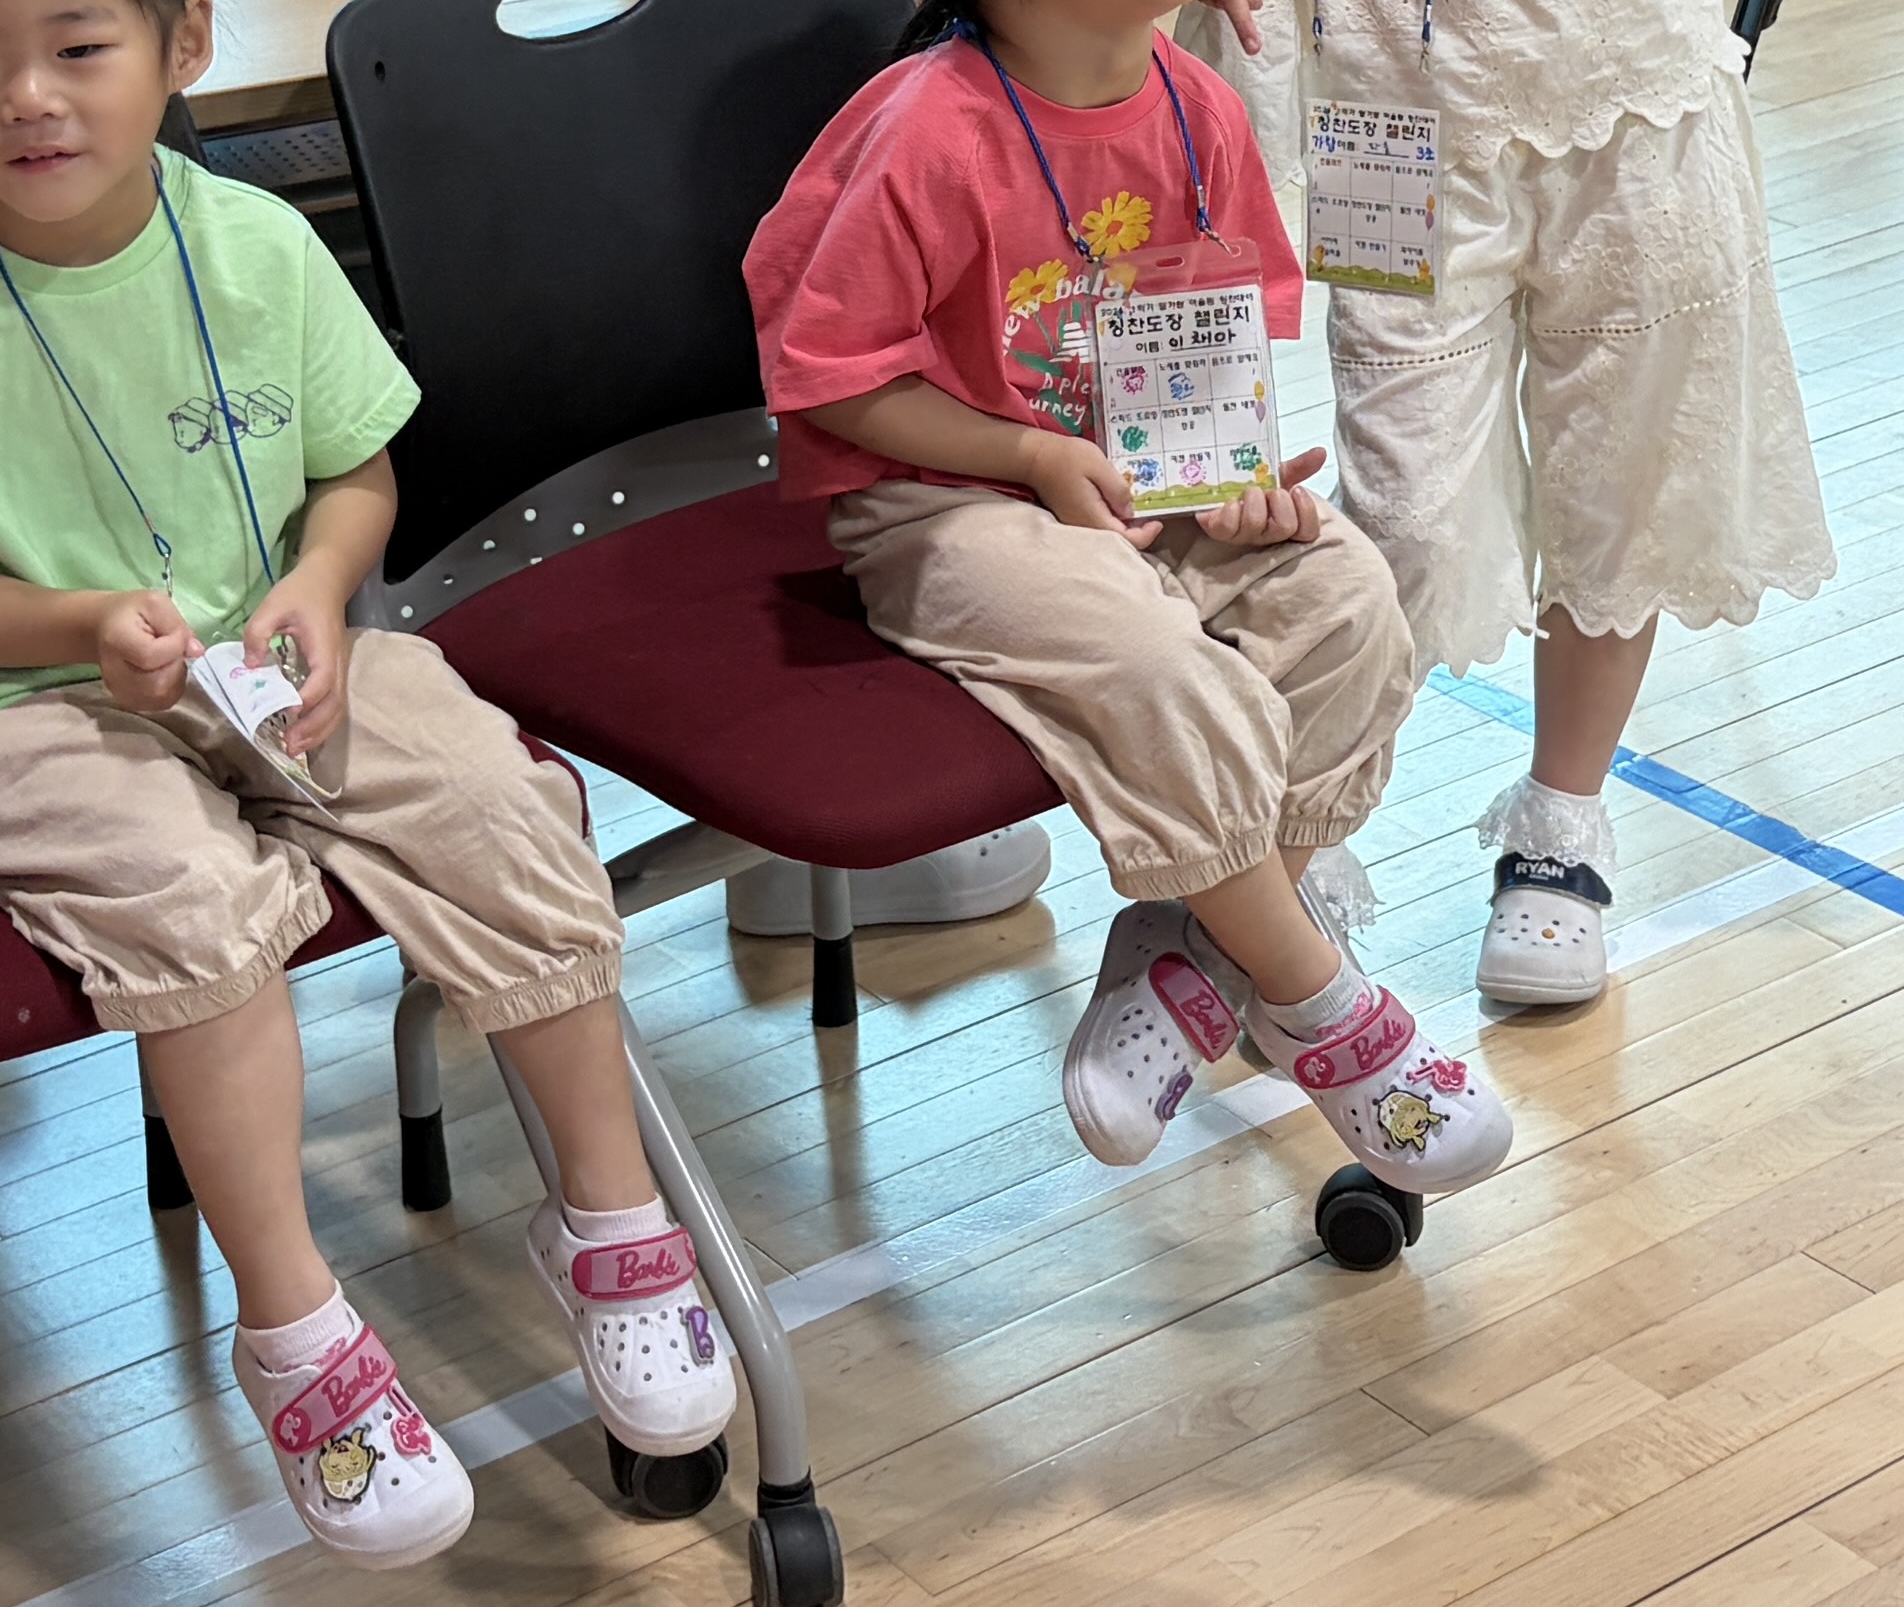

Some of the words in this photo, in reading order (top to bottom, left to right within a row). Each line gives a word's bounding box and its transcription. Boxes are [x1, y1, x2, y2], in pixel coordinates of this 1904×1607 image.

[1515, 861, 1565, 879] RYAN
[616, 1248, 681, 1289] Barbie
[321, 1355, 387, 1418] Barbie
